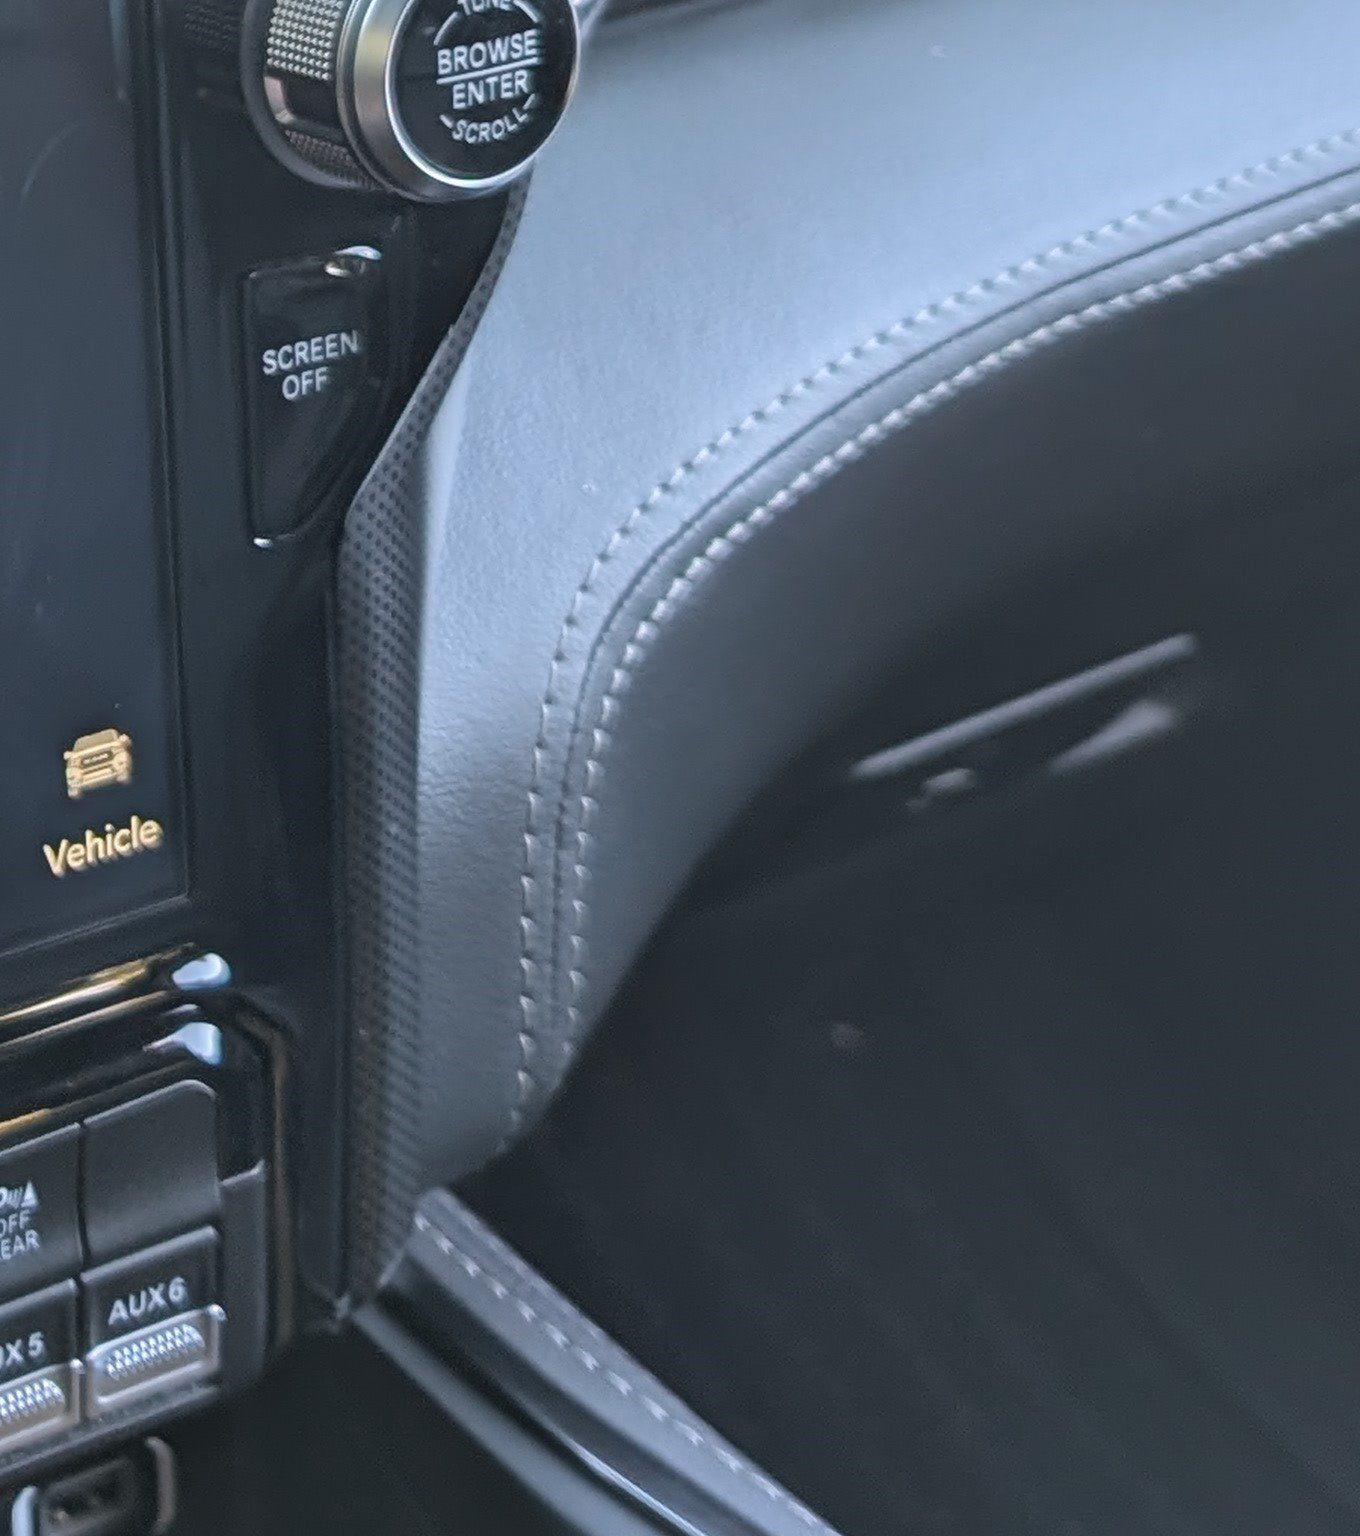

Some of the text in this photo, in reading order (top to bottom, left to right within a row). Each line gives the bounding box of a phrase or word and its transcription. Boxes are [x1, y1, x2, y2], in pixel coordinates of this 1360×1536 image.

[437, 29, 541, 75] BROWSE
[452, 70, 529, 110] ENTER
[452, 106, 528, 145] SCROLL
[262, 329, 362, 376] SCREEN
[282, 366, 329, 402] OFF
[43, 814, 163, 877] Vehicle
[108, 1276, 186, 1326] AUX 6
[28, 1331, 44, 1359] 5
